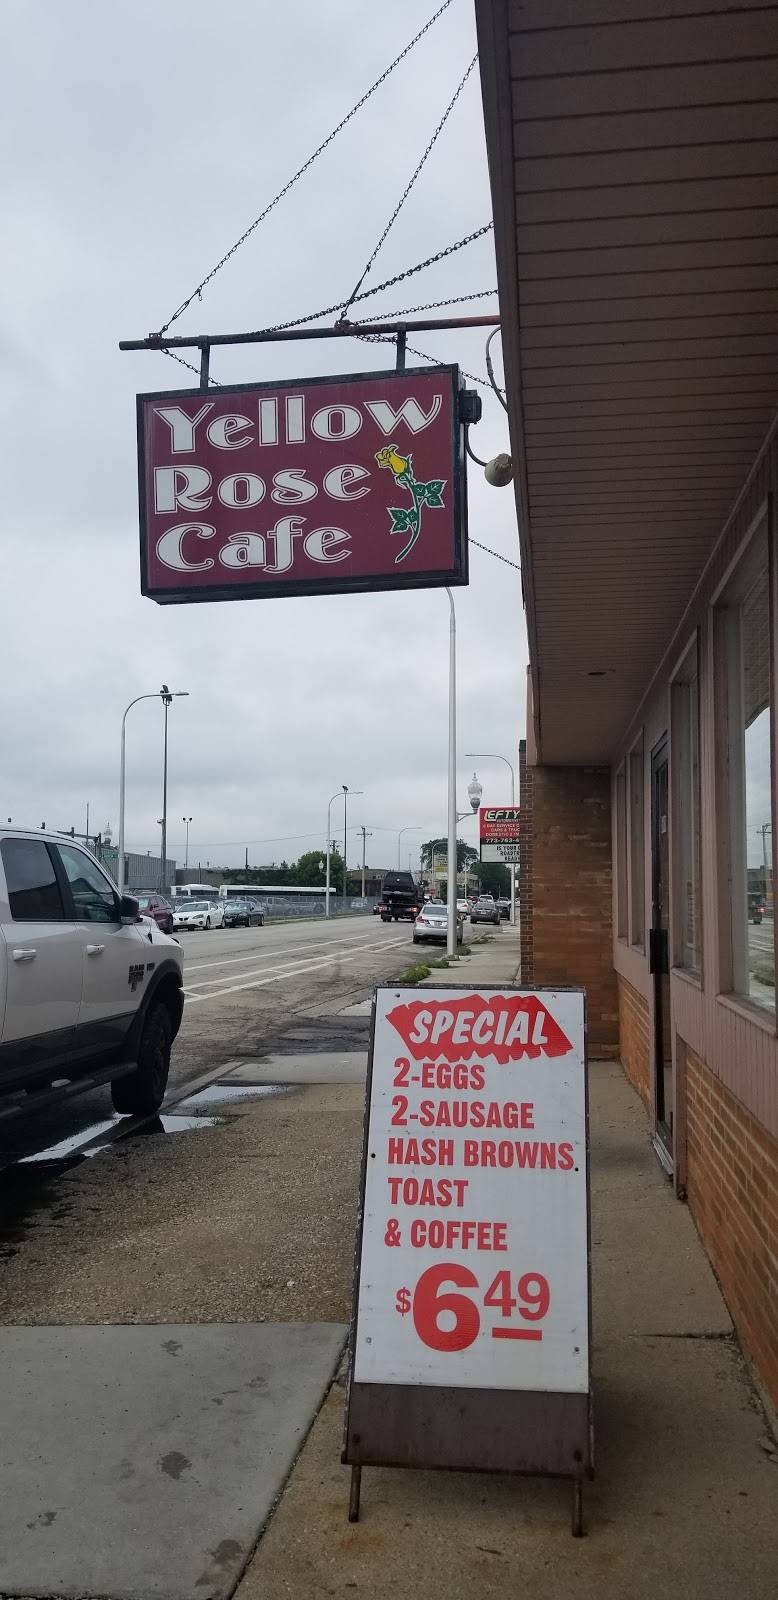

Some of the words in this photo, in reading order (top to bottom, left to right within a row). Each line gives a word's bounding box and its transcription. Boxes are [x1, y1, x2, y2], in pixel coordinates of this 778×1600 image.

[153, 394, 442, 454] Yellow
[153, 464, 371, 514] Rose
[155, 515, 352, 574] Cafe
[484, 810, 520, 822] LEFTY
[409, 1009, 548, 1046] SPECIAL
[393, 1057, 485, 1090] 2-EGGS
[391, 1095, 535, 1129] 2-SAUSAGE
[387, 1138, 454, 1166] HASH
[463, 1140, 574, 1170] BROWNS
[388, 1177, 469, 1207] TOAST
[384, 1218, 401, 1247] &
[410, 1219, 508, 1251] COFFEE
